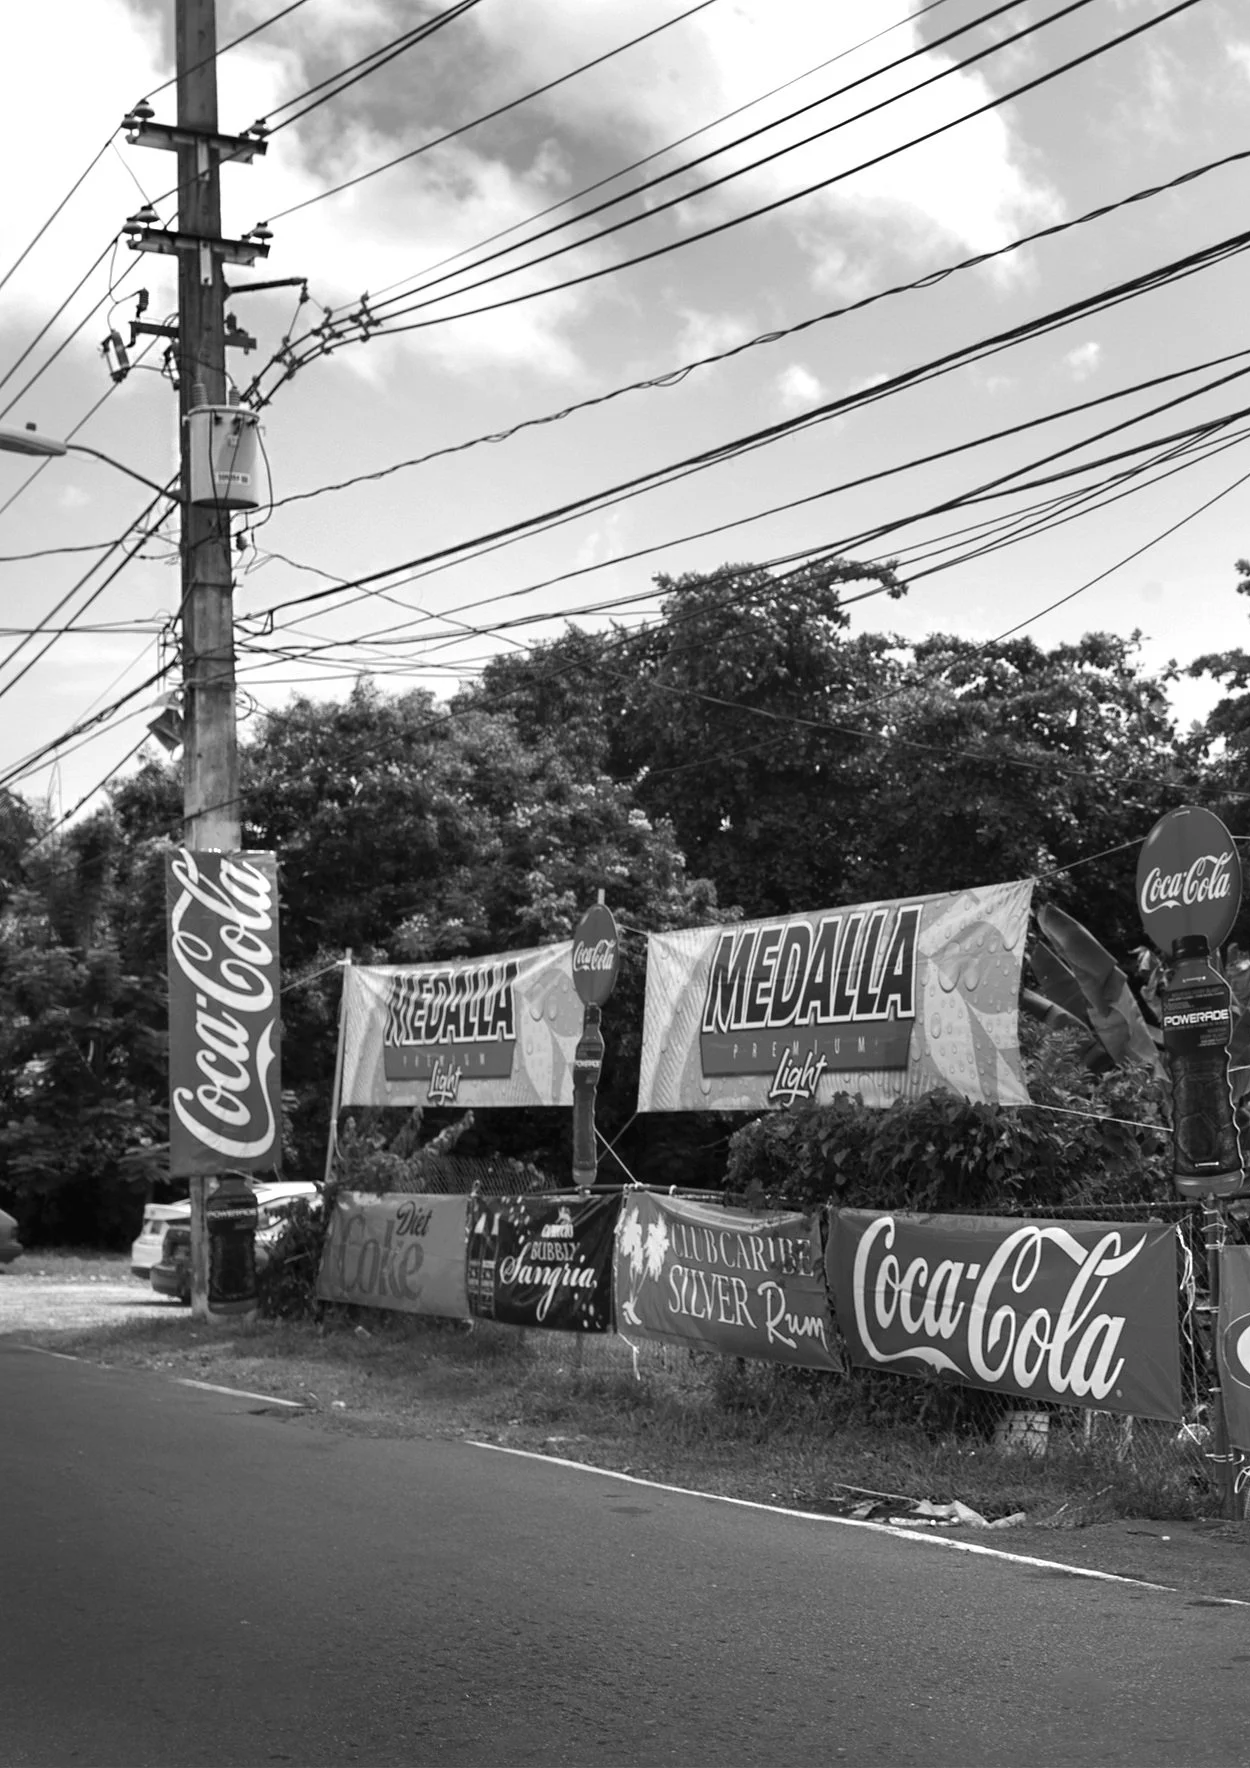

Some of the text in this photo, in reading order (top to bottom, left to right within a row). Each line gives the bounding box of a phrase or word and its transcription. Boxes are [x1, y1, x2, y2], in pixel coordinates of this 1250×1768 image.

[1141, 851, 1234, 914] Coca-Cola
[171, 848, 276, 1158] Coca-Cola
[384, 957, 521, 1047] MEDALLA
[702, 904, 924, 1034] MEDALLA
[1164, 1009, 1229, 1027] POWERADE
[428, 1060, 463, 1105] Light
[769, 1047, 828, 1107] Light
[338, 1214, 425, 1300] Coke
[396, 1201, 432, 1238] Diet
[530, 1241, 581, 1261] BUBBLY
[500, 1242, 597, 1322] Sangria
[669, 1264, 829, 1352] SILVER Rum
[853, 1217, 1147, 1399] Coca-Cola
